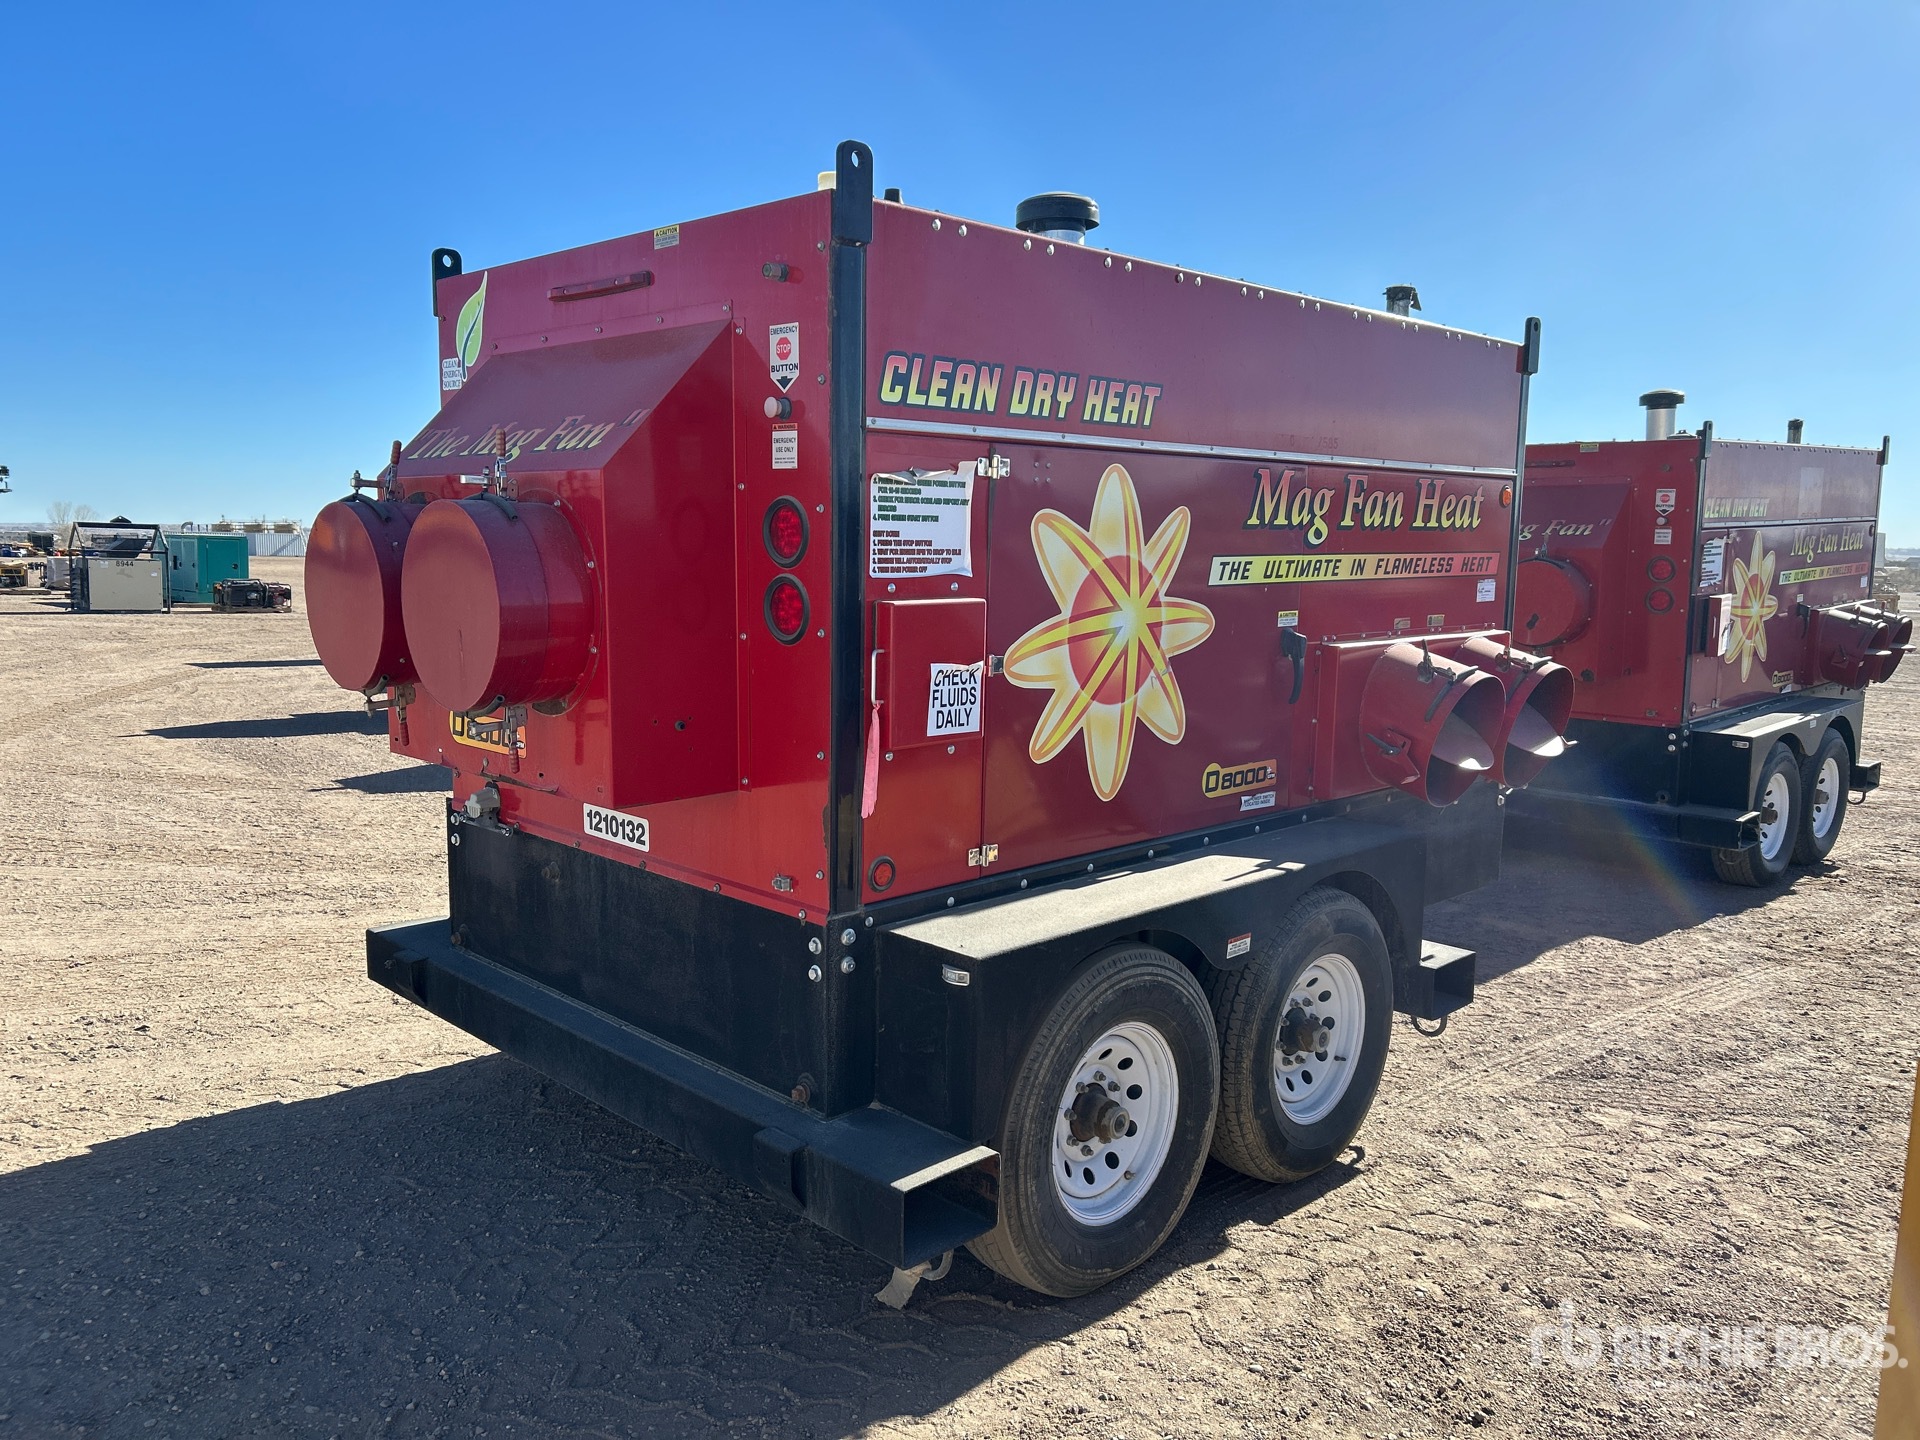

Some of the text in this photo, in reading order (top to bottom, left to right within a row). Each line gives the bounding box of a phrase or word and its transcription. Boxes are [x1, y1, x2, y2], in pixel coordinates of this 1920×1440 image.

[660, 227, 678, 236] CAUTION
[770, 326, 798, 335] EMERGENCY
[776, 344, 791, 354] STOP
[771, 363, 798, 372] BUTTON
[879, 353, 1162, 428] CLEAN DRY HEAT
[1244, 468, 1484, 547] Mag Fan Heat
[1704, 498, 1769, 518] CLEAN DRY HEAT
[1790, 526, 1864, 563] Mag Fan Heat
[1219, 556, 1493, 580] THE ULTIMATE IN FLAMELESS HEAT
[1781, 573, 1792, 583] THE
[1794, 569, 1817, 581] ULTIMATE
[1827, 565, 1853, 576] FLAMELESS
[934, 667, 980, 687] CHECK
[932, 687, 977, 708] FLUIDS
[936, 707, 972, 729] DAILY
[587, 809, 646, 846] 1210132
